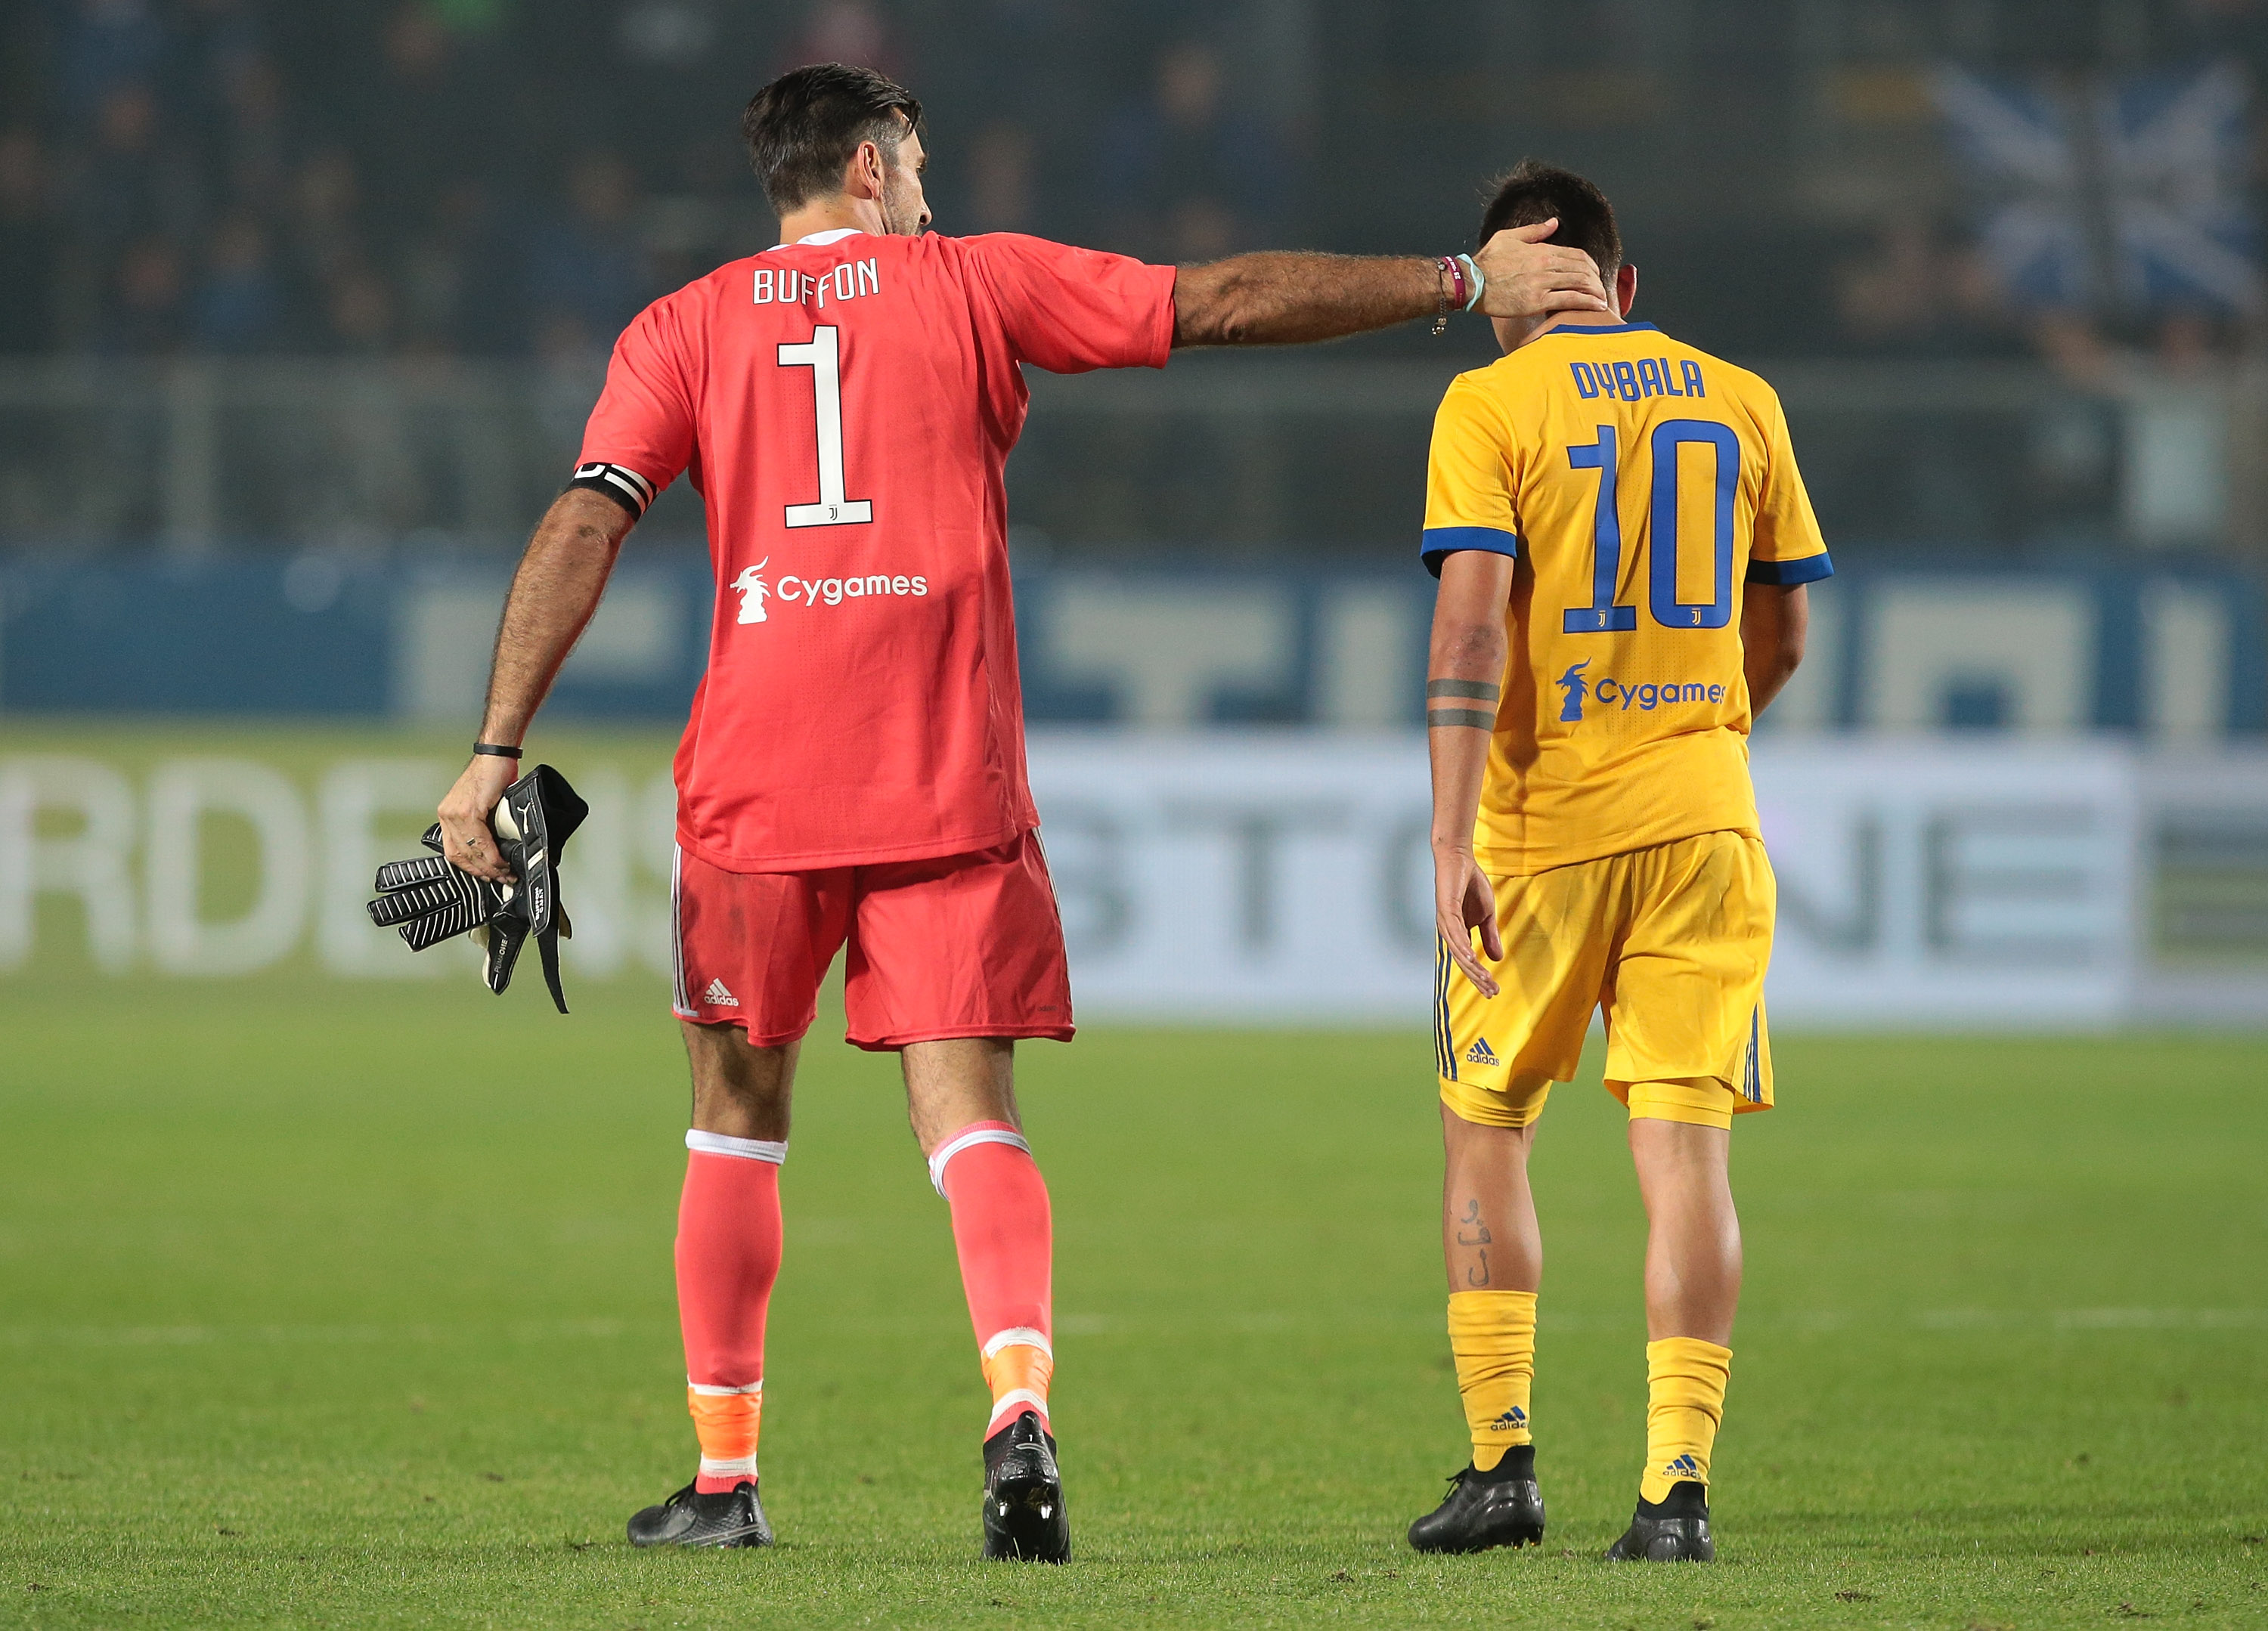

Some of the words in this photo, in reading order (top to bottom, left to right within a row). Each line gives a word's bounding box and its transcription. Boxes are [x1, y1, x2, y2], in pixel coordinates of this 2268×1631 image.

[754, 258, 879, 308] BUFFON
[1570, 357, 1705, 401] DYBALA
[777, 325, 872, 528] 1
[1563, 419, 1739, 633] 10
[777, 574, 928, 606] Cygames
[704, 995, 739, 1007] adidas
[1467, 1054, 1500, 1066] adidas
[1490, 1421, 1526, 1431] adida
